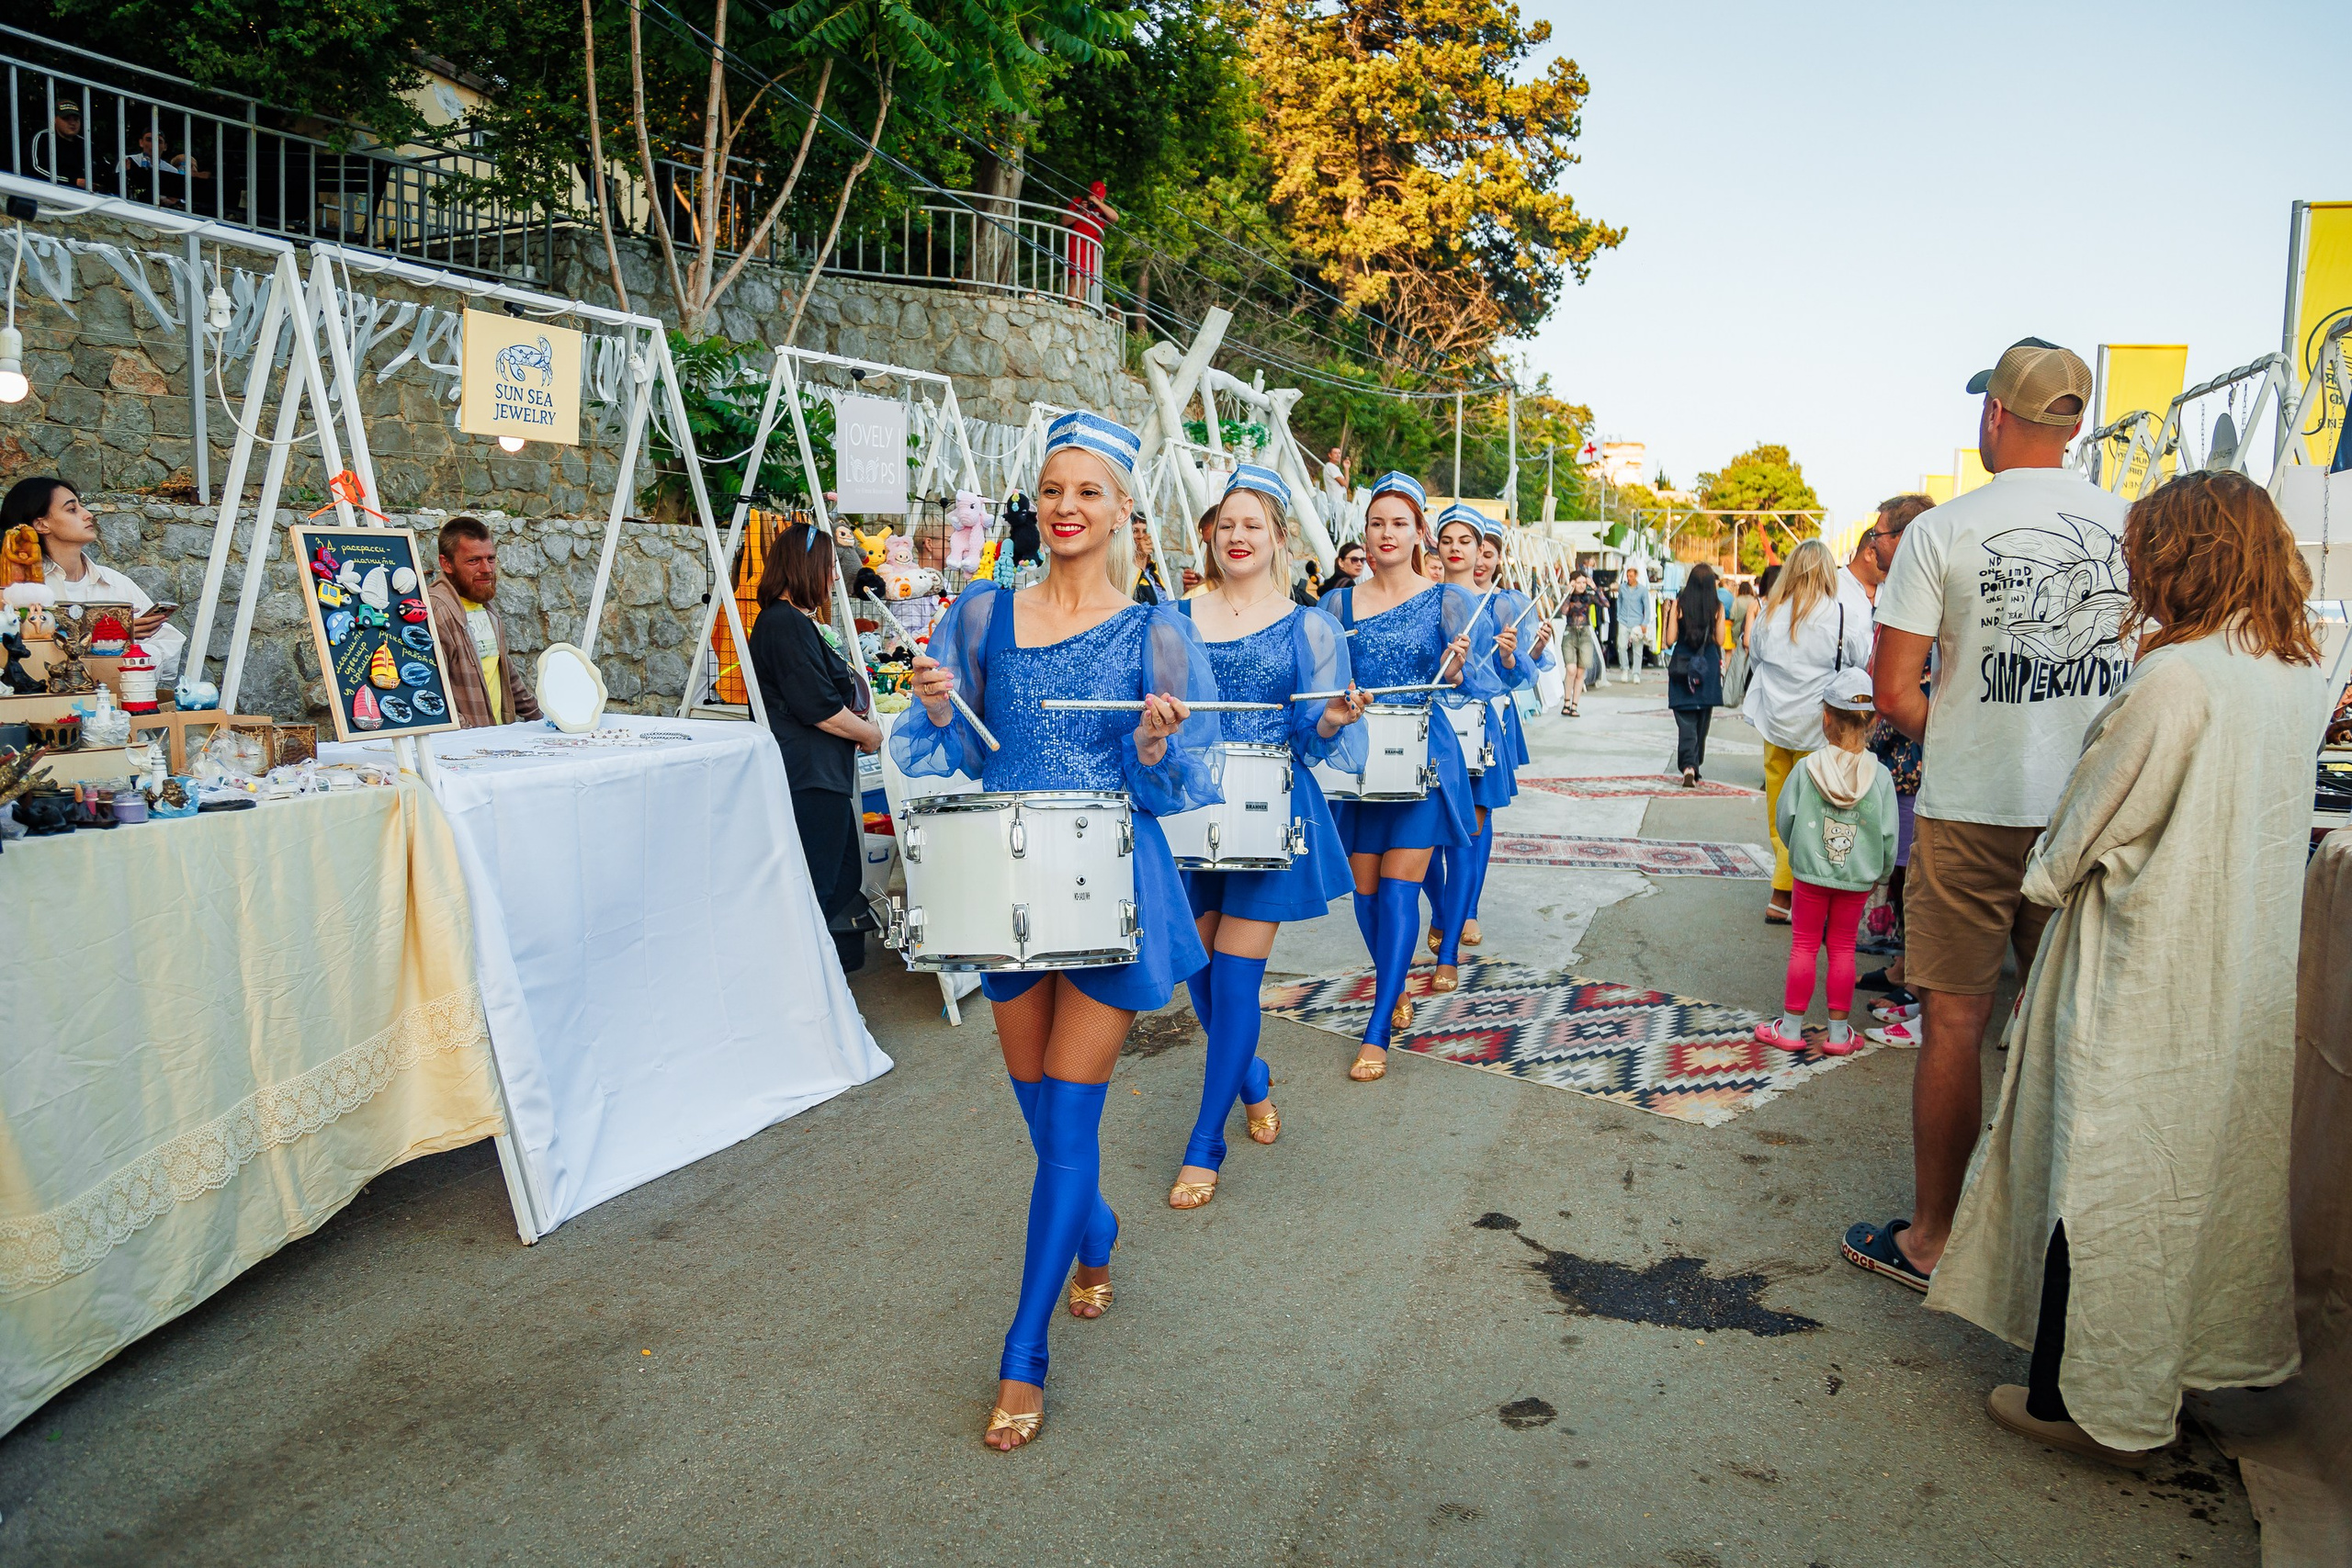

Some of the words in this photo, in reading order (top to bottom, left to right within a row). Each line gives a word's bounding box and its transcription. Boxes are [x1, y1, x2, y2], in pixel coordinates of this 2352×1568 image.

[495, 383, 524, 401] SUN
[527, 389, 553, 407] SEA
[492, 403, 557, 425] JEWELRY
[1981, 616, 2000, 627] AND
[1841, 1243, 1875, 1270] crocs
